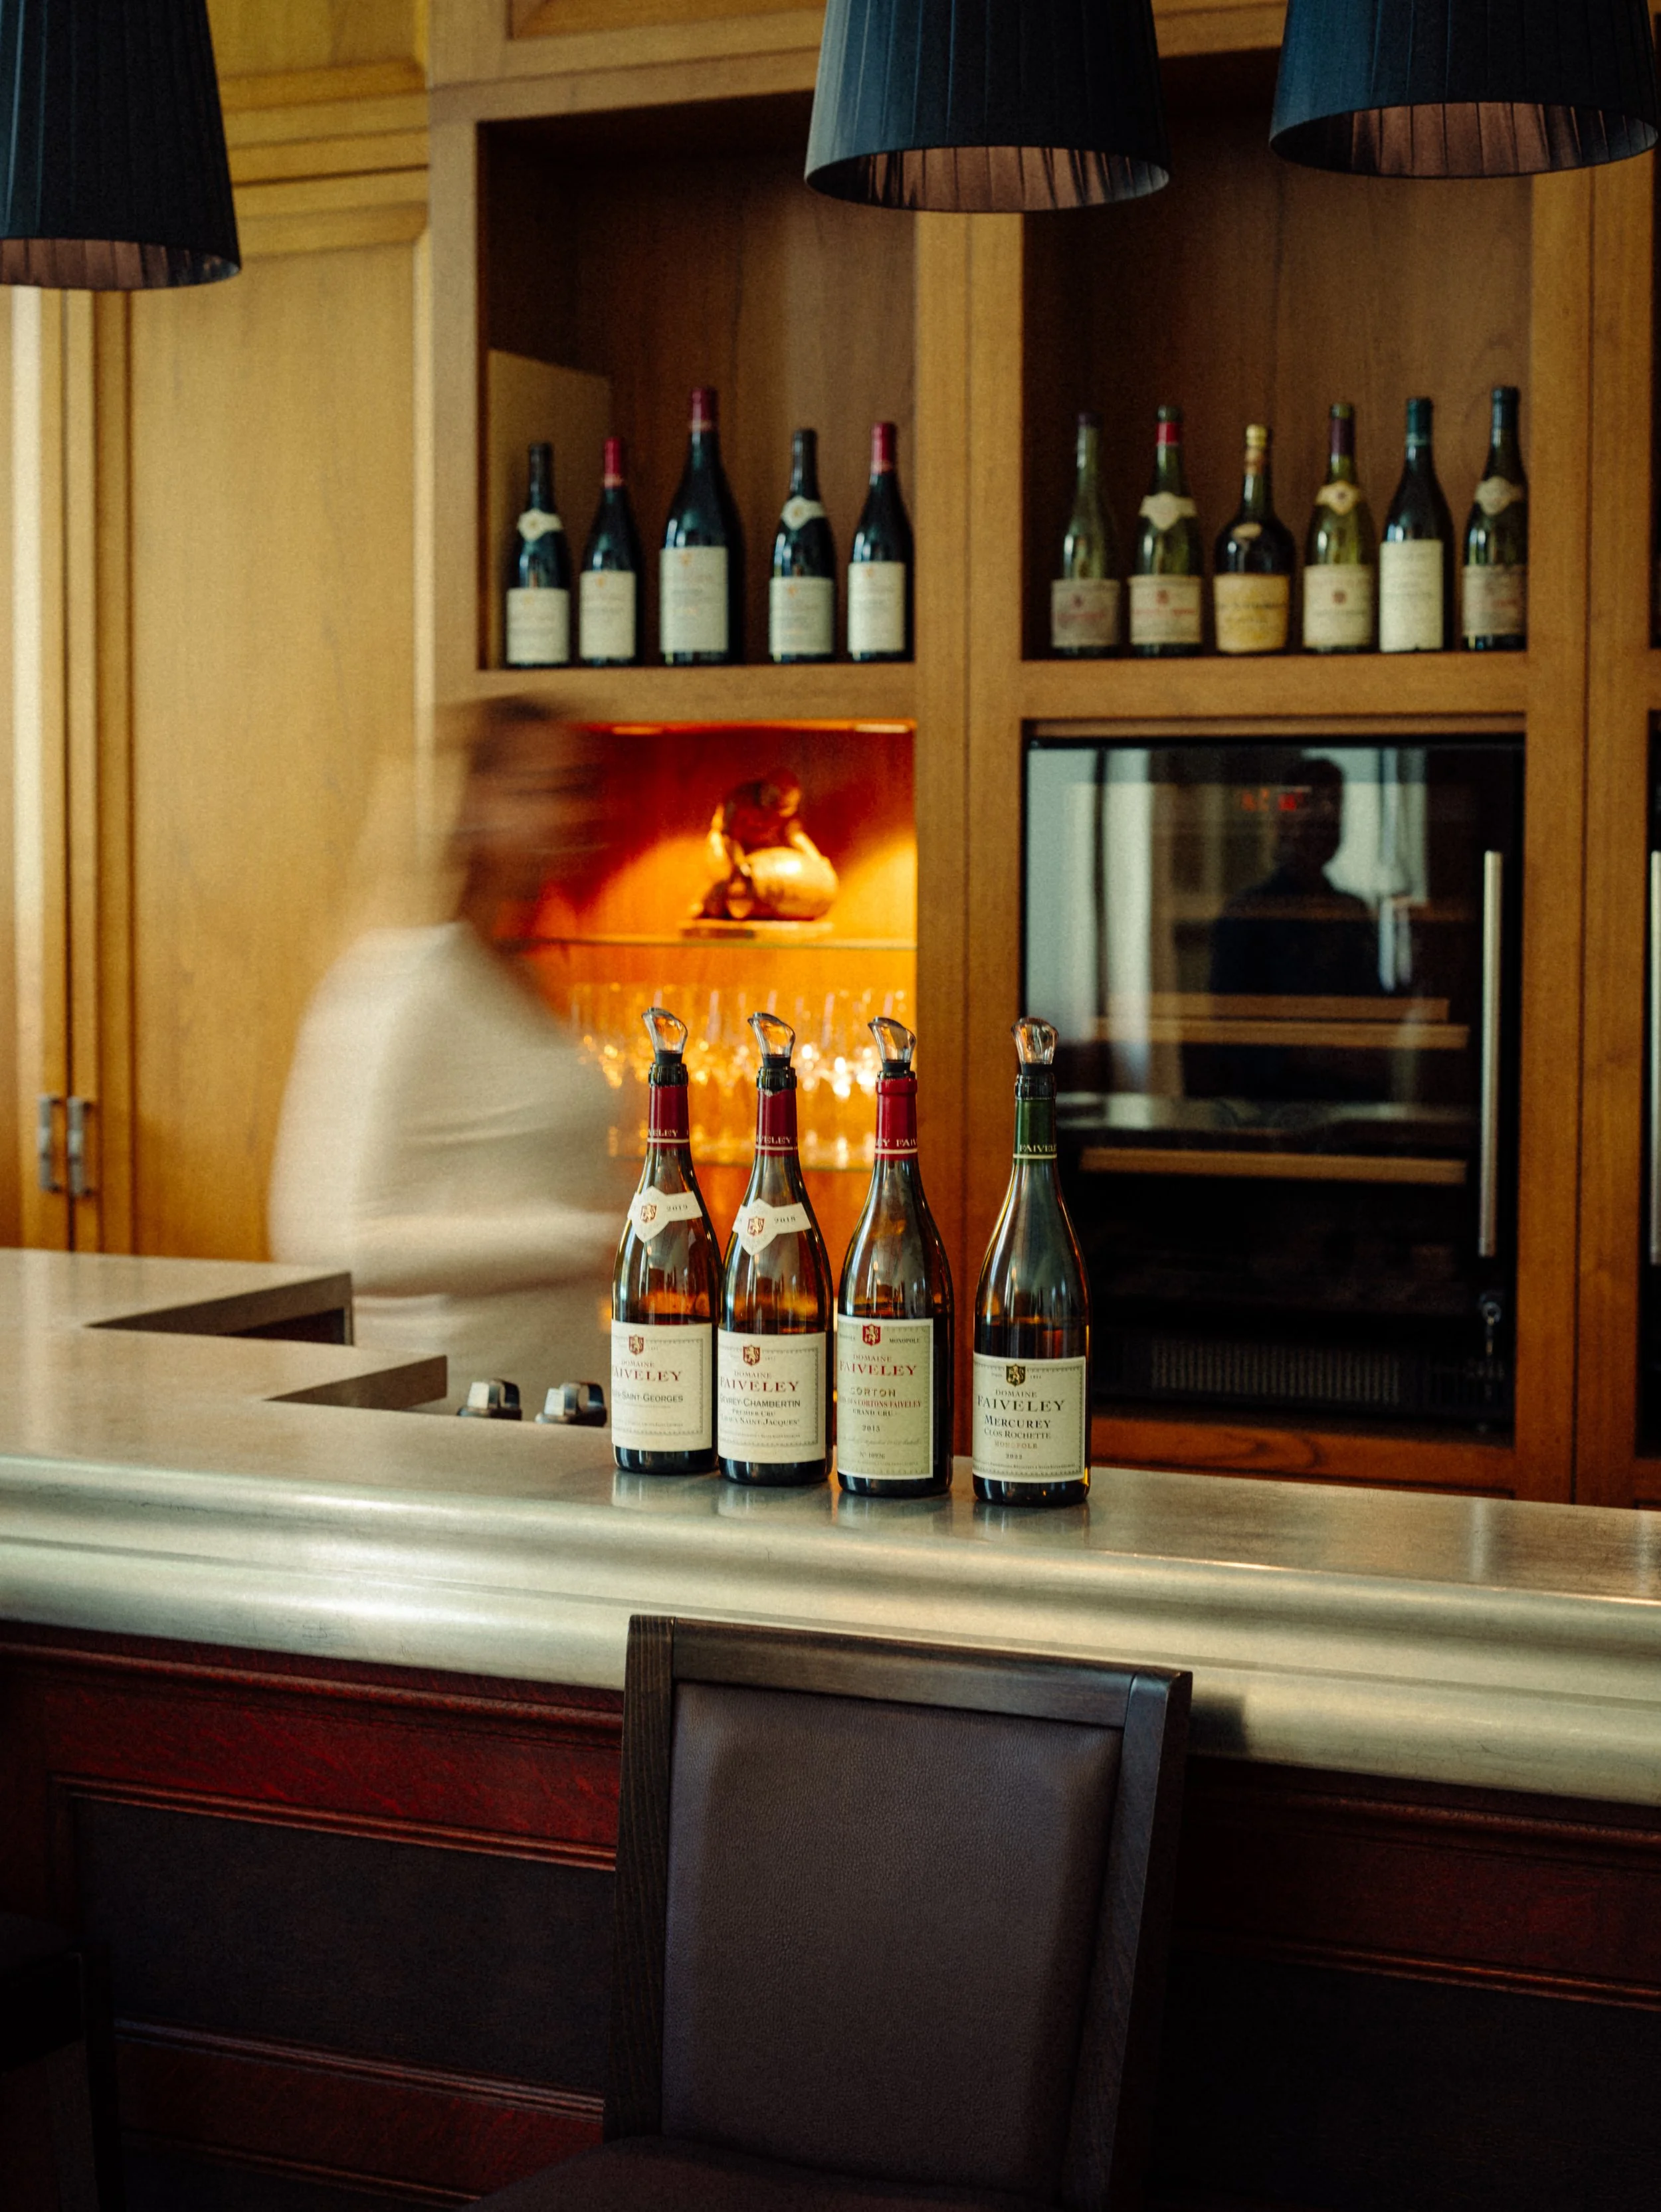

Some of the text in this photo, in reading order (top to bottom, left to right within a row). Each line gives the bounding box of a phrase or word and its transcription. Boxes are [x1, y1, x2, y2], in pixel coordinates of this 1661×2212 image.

[621, 1360, 654, 1368] DOMAINE
[839, 1360, 916, 1376] FAIVELEY
[733, 1370, 772, 1380] DOMAINE
[720, 1376, 799, 1392] FAIVELEY
[850, 1387, 896, 1398] CORTON
[995, 1389, 1037, 1398] DOMAINE
[977, 1395, 1065, 1412] FAIVELEY
[984, 1414, 1051, 1429] MERCUREY
[984, 1427, 1051, 1439] CLOS ROCHETTE
